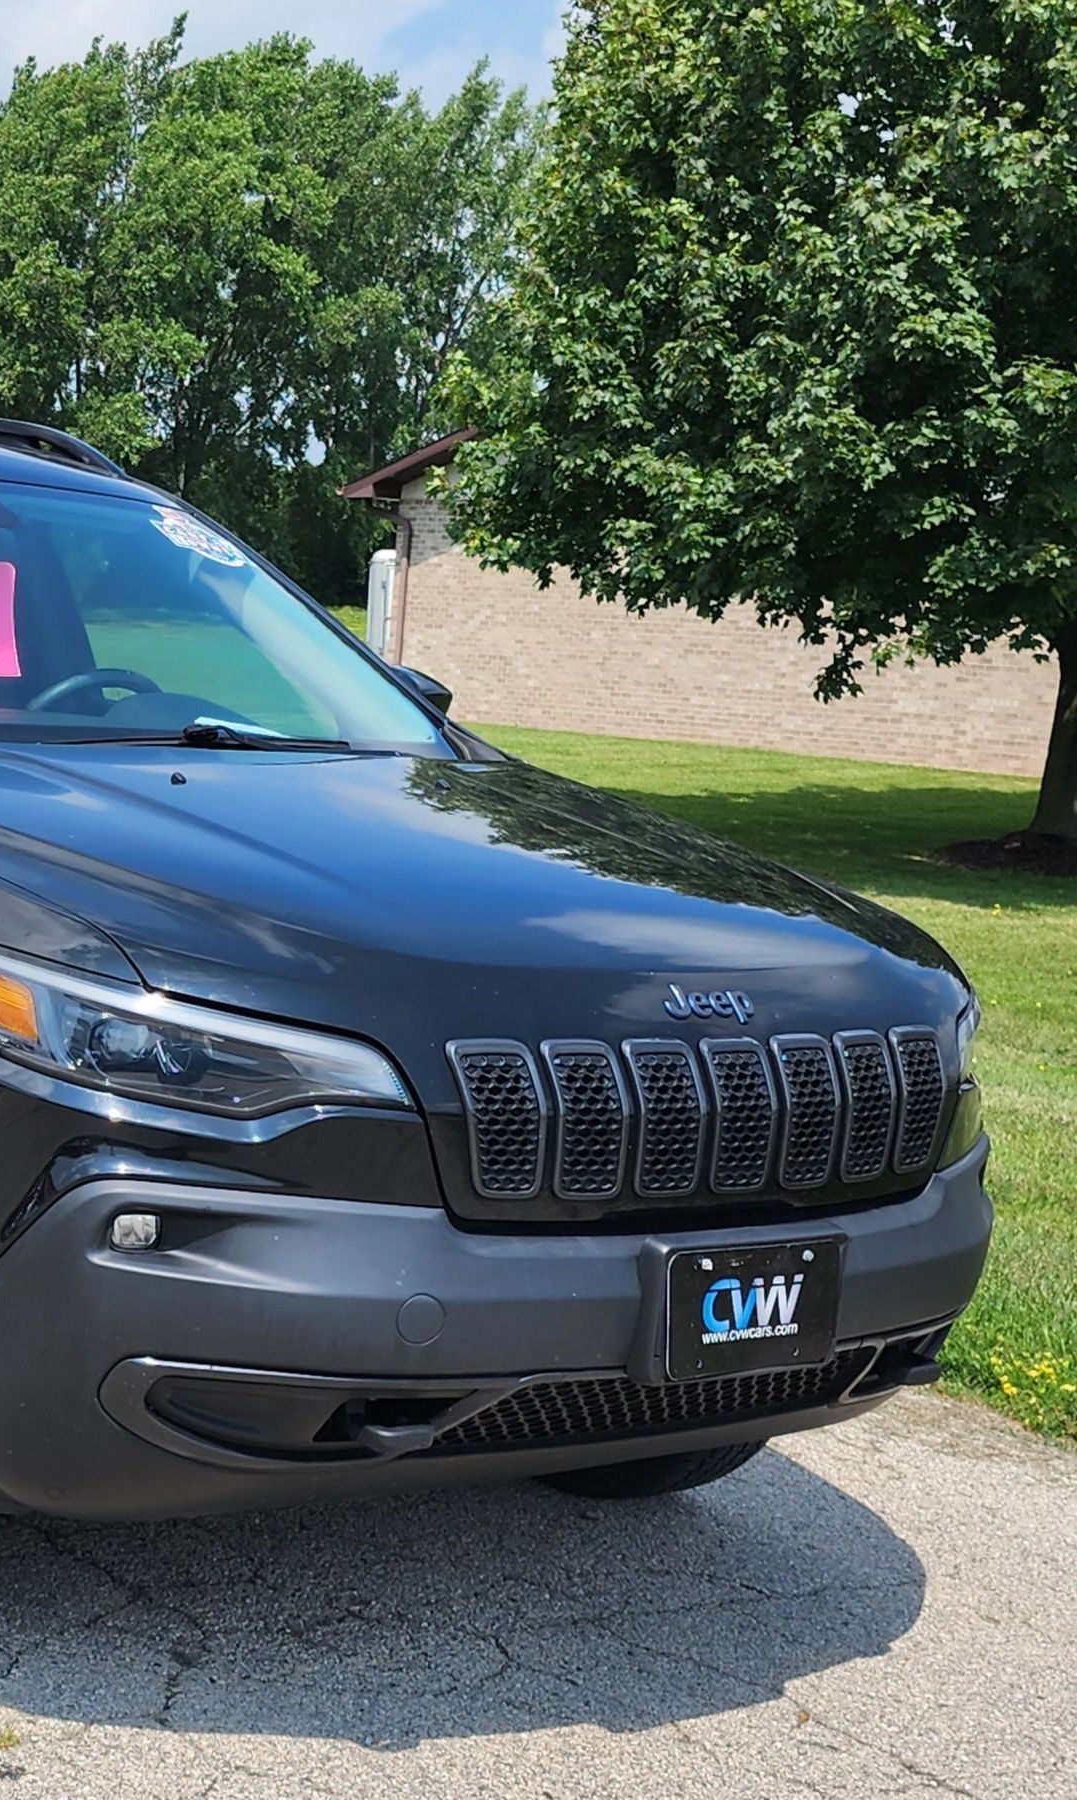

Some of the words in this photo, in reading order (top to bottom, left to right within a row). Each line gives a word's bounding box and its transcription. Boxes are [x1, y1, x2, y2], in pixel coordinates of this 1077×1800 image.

[663, 983, 755, 1025] Jeep
[701, 1273, 806, 1334] CVW
[701, 1322, 799, 1345] www.cvwcars.com
